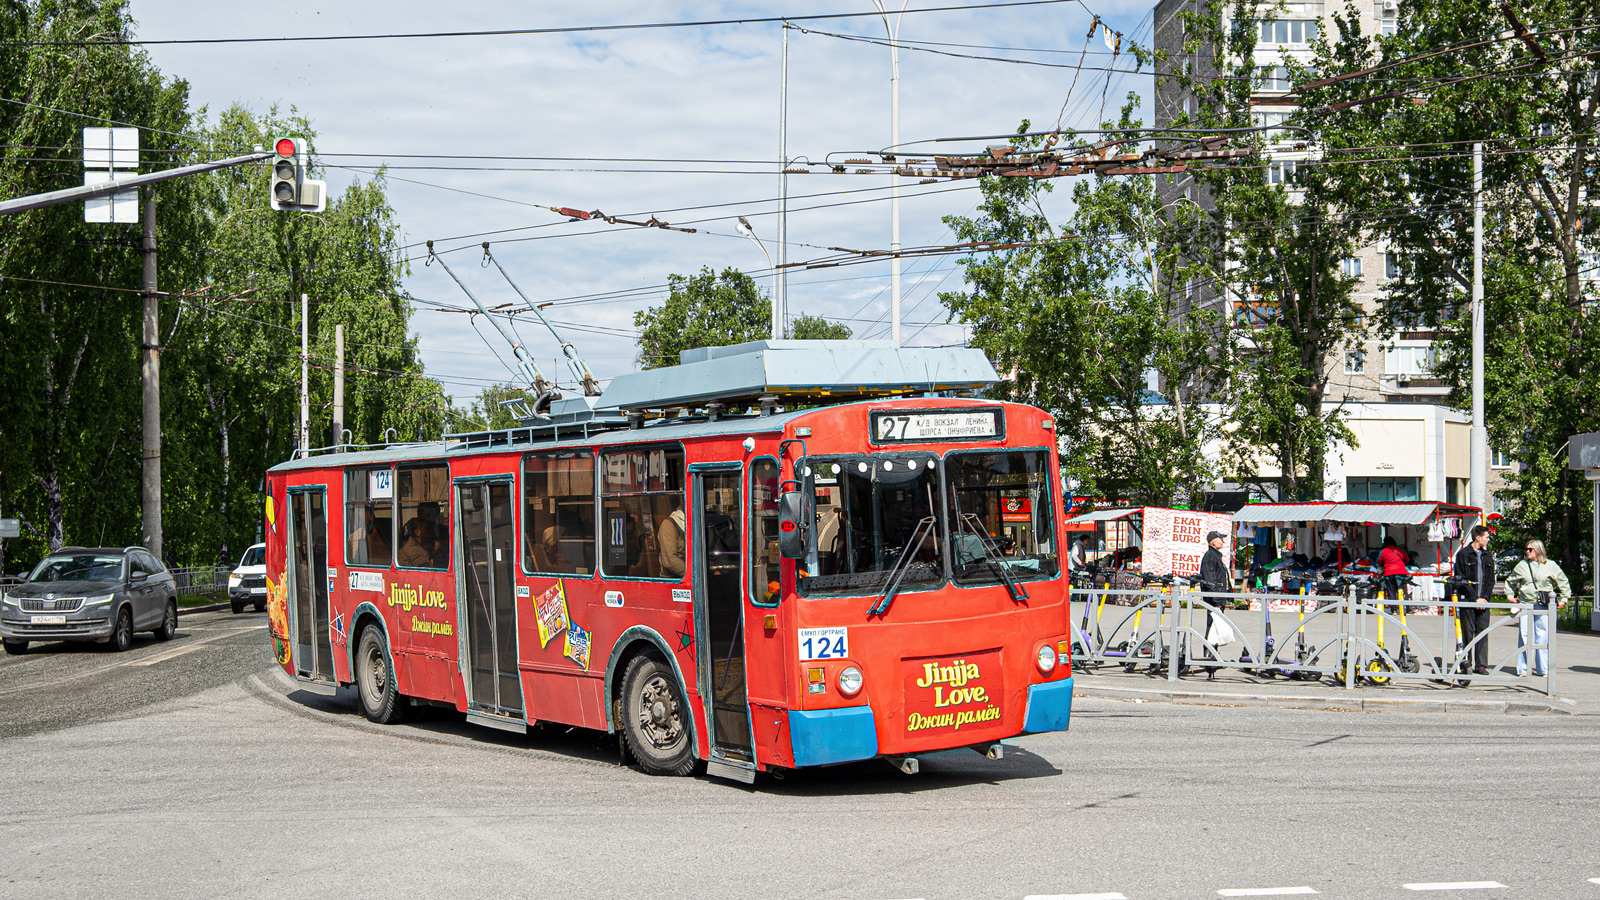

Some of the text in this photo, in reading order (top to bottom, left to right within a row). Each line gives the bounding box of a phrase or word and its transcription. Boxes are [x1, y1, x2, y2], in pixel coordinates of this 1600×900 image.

[882, 417, 911, 440] 27
[934, 418, 959, 426] ВОКЗАЛ
[965, 417, 988, 425] ЛЕНИНА
[920, 427, 942, 436] ЩОРСА
[376, 471, 389, 489] 124
[1173, 516, 1202, 526] EKAT
[1172, 525, 1201, 535] ERIN
[1172, 533, 1201, 544] BURG
[1171, 553, 1200, 563] EKAT
[1171, 562, 1200, 572] ERIN
[351, 572, 359, 588] 27
[388, 582, 448, 612] Jinjja Love,
[673, 590, 691, 600] ВЫХОД
[411, 615, 453, 638] Джин рамён
[803, 636, 846, 658] 124
[916, 659, 981, 688] Jinjja
[934, 686, 989, 708] Love,
[907, 704, 1001, 731] Джин рамён
